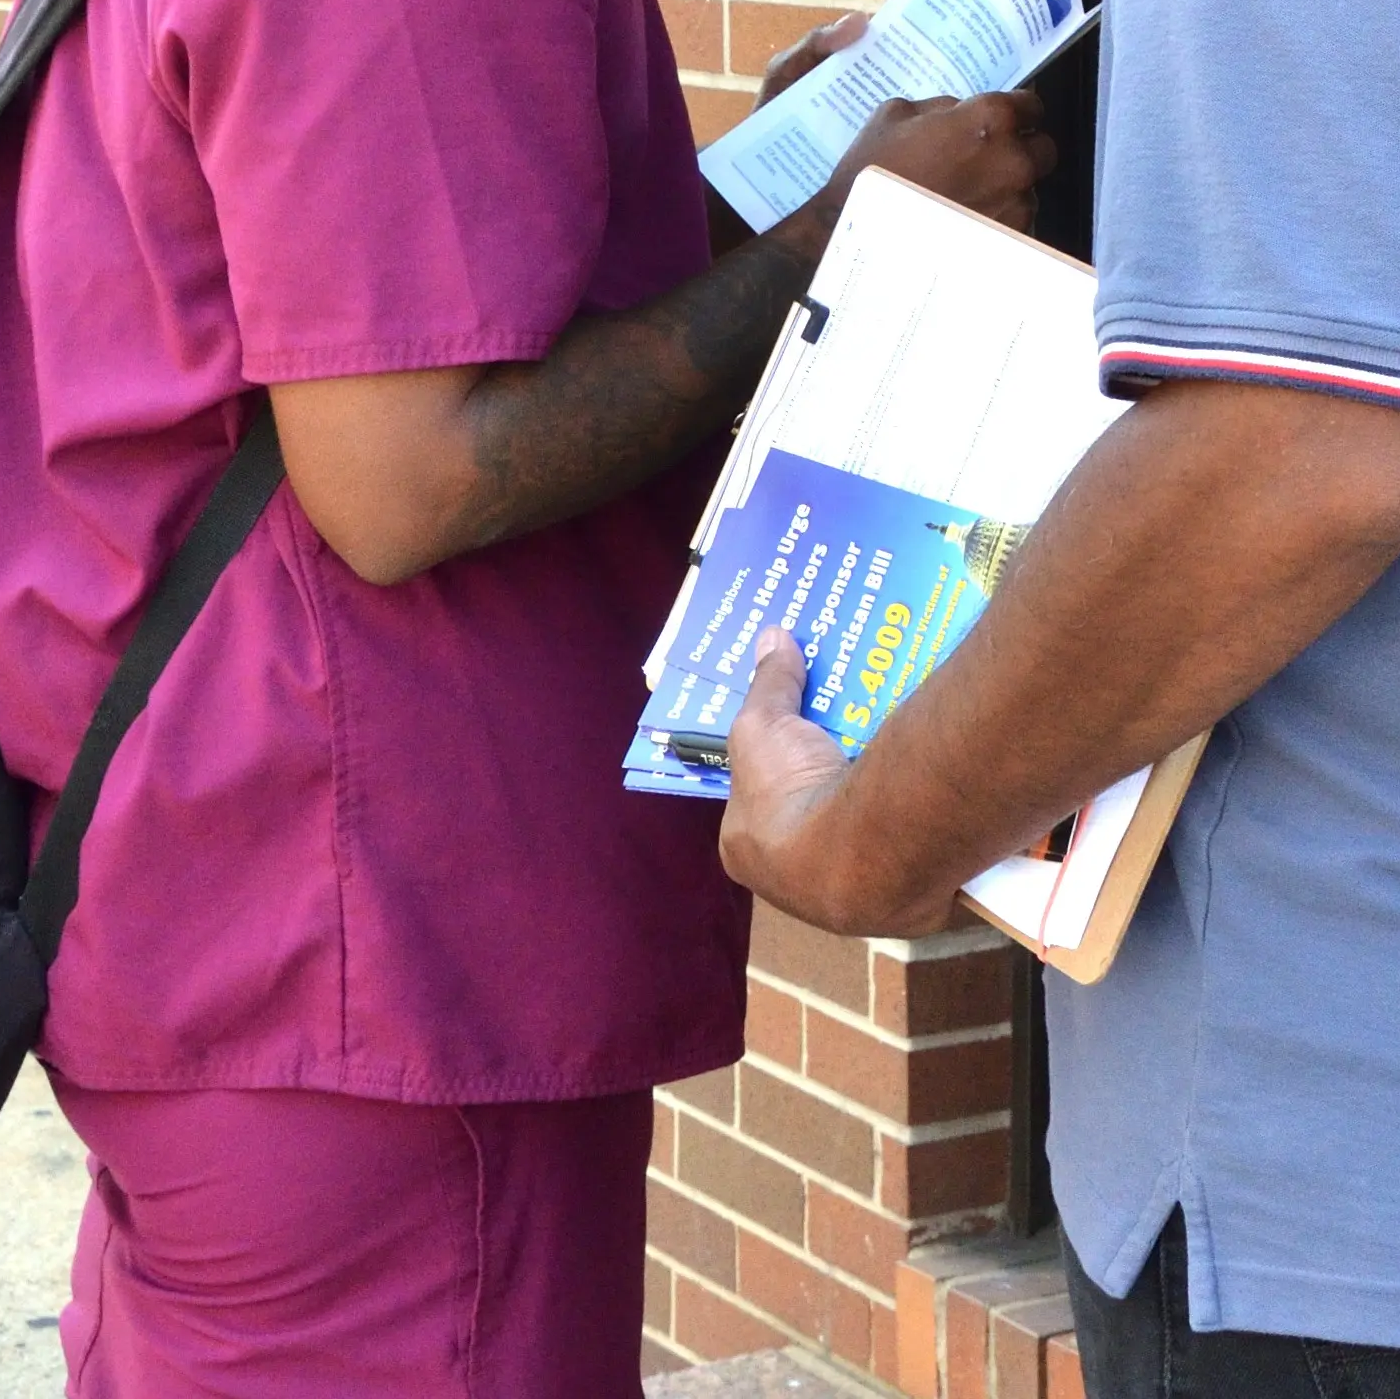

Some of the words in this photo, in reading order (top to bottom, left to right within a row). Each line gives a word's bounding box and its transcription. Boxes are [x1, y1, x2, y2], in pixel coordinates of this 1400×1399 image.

[689, 632, 713, 662] Dear
[707, 568, 750, 632] Neighbors,
[716, 609, 763, 675] Please
[753, 558, 789, 606] Help
[777, 504, 810, 554] Urge
[781, 544, 827, 631] enators
[812, 594, 875, 712] Bipartisan
[865, 550, 892, 590] Bill
[892, 662, 914, 697] Gong
[908, 634, 923, 660] and
[917, 583, 942, 631] Victims
[939, 565, 949, 581] of
[931, 579, 967, 652] Harvesting
[667, 690, 689, 718] Dear
[844, 603, 910, 728] S.4009
